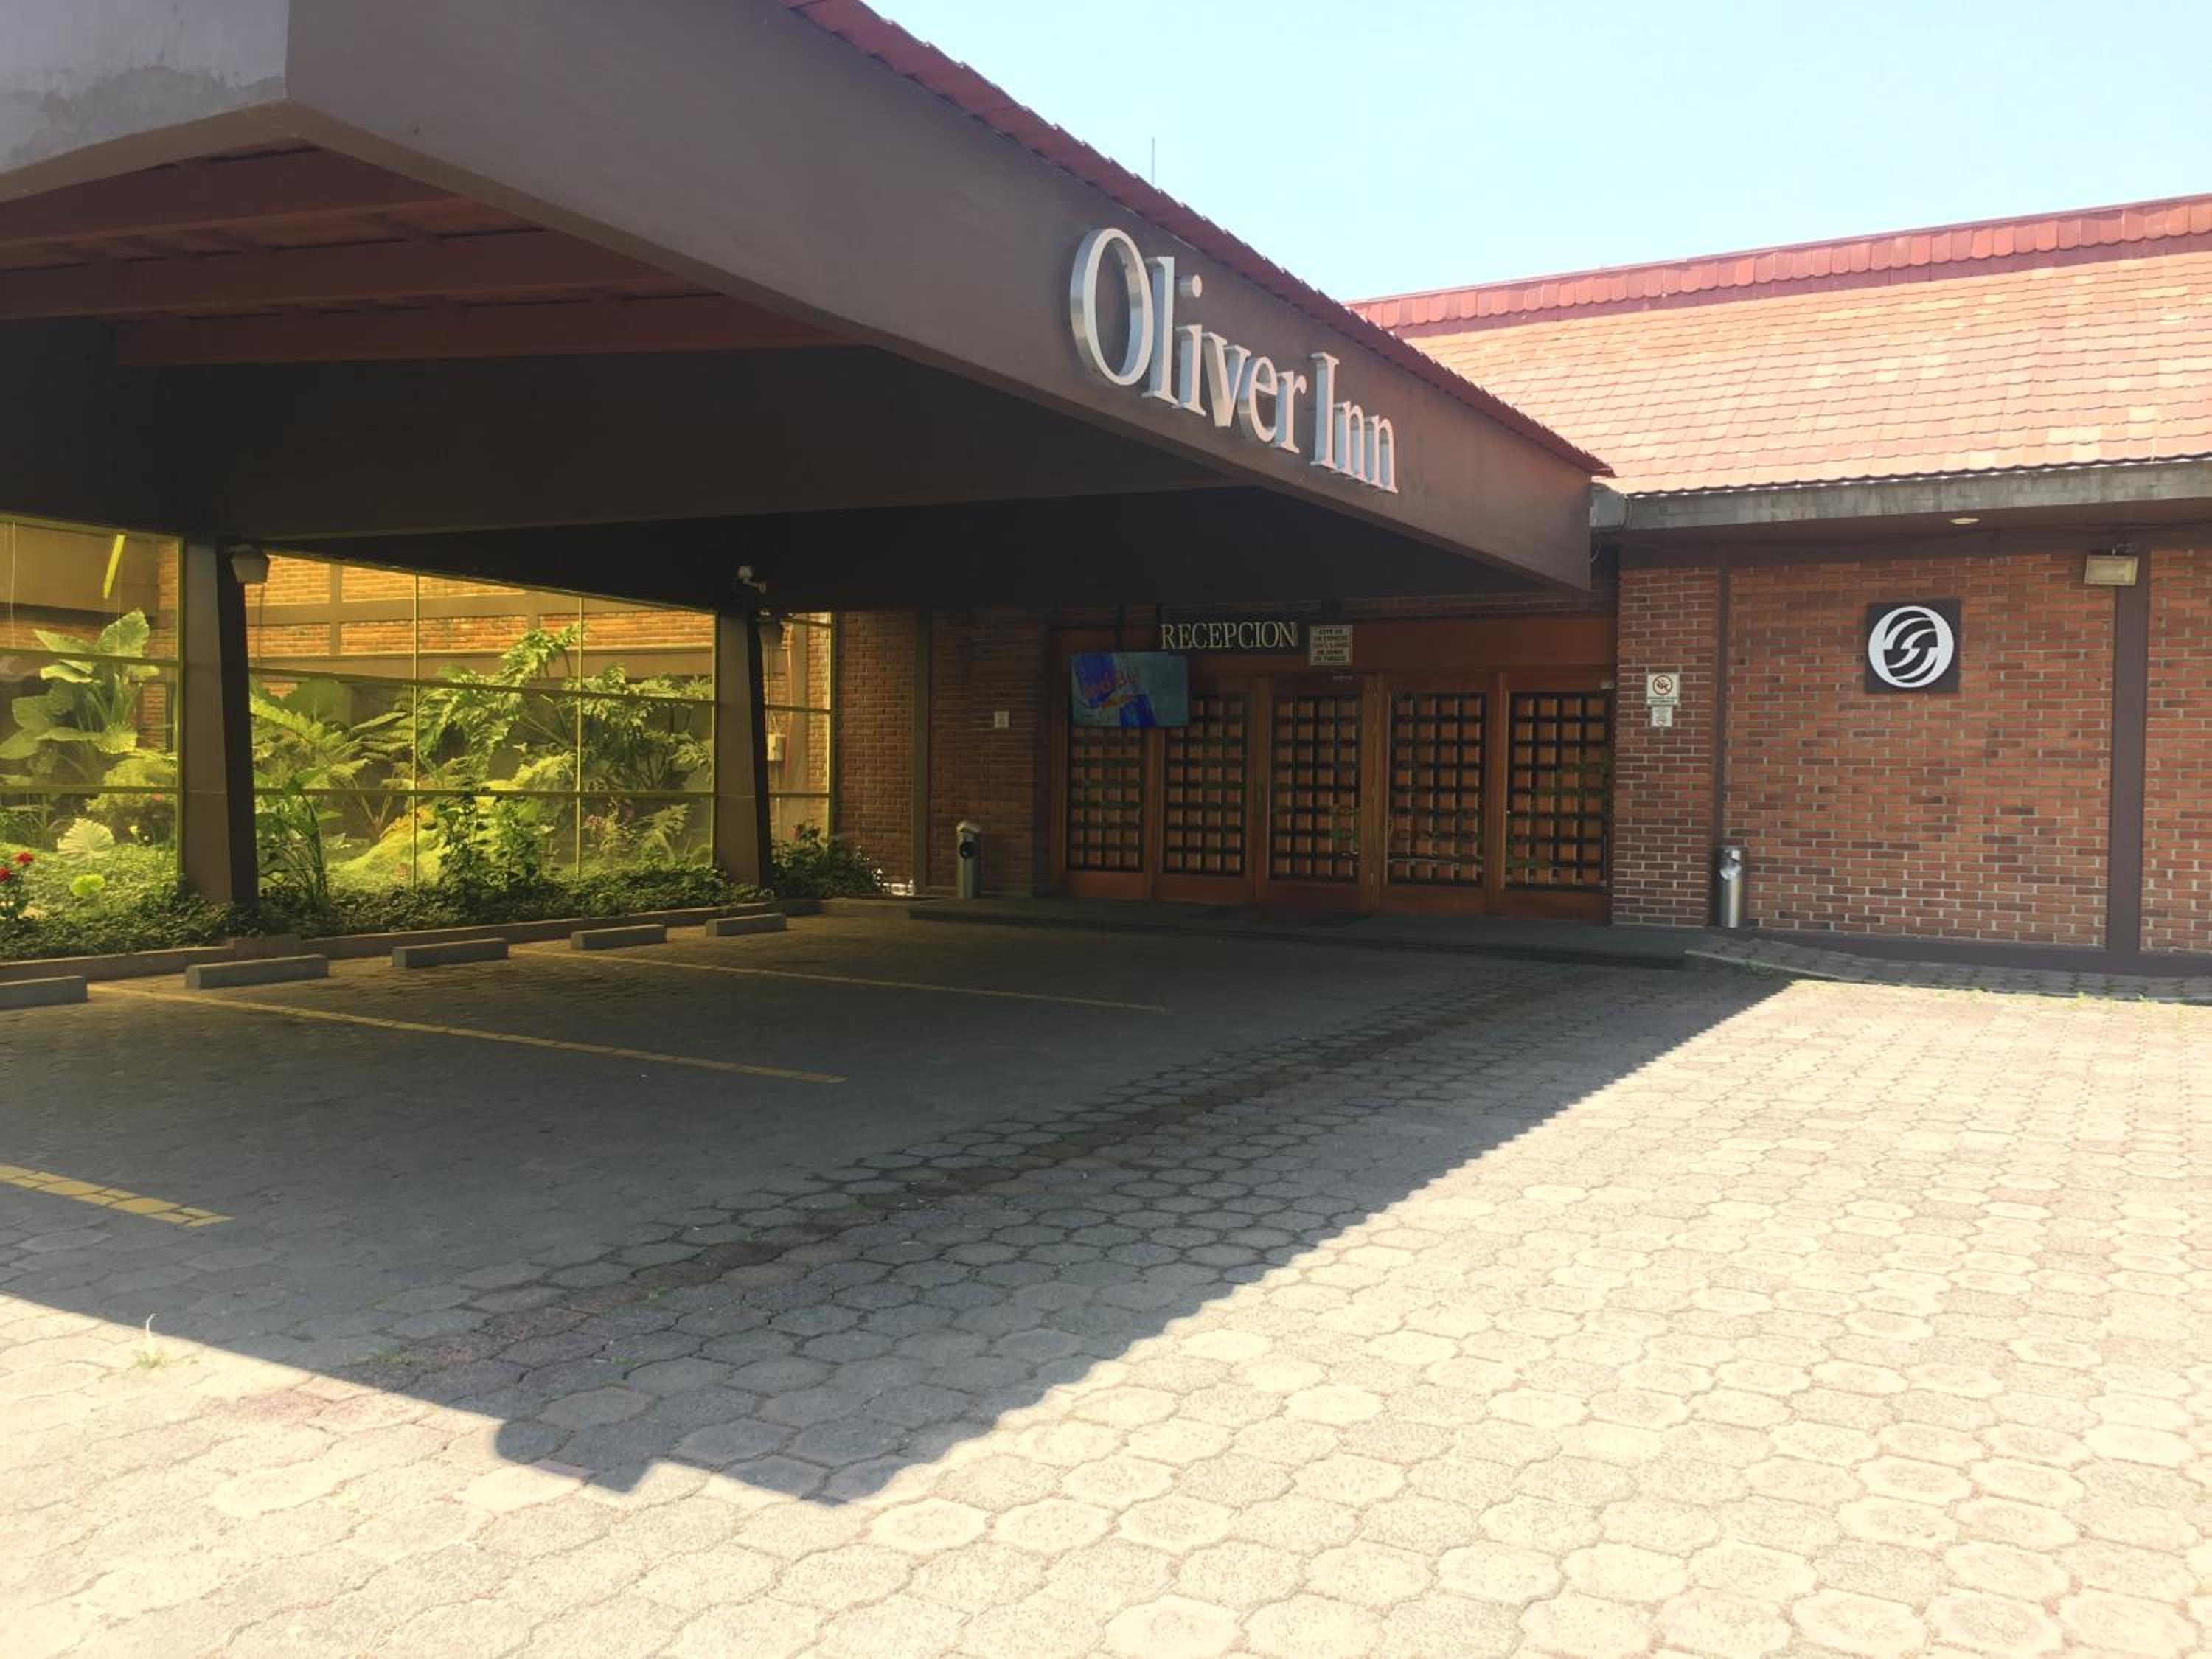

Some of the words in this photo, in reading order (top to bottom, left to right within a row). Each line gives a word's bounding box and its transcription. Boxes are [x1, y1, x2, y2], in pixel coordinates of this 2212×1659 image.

[1070, 228, 1307, 454] Oliver
[1310, 352, 1398, 493] Inn
[1161, 621, 1298, 650] RECEPCION
